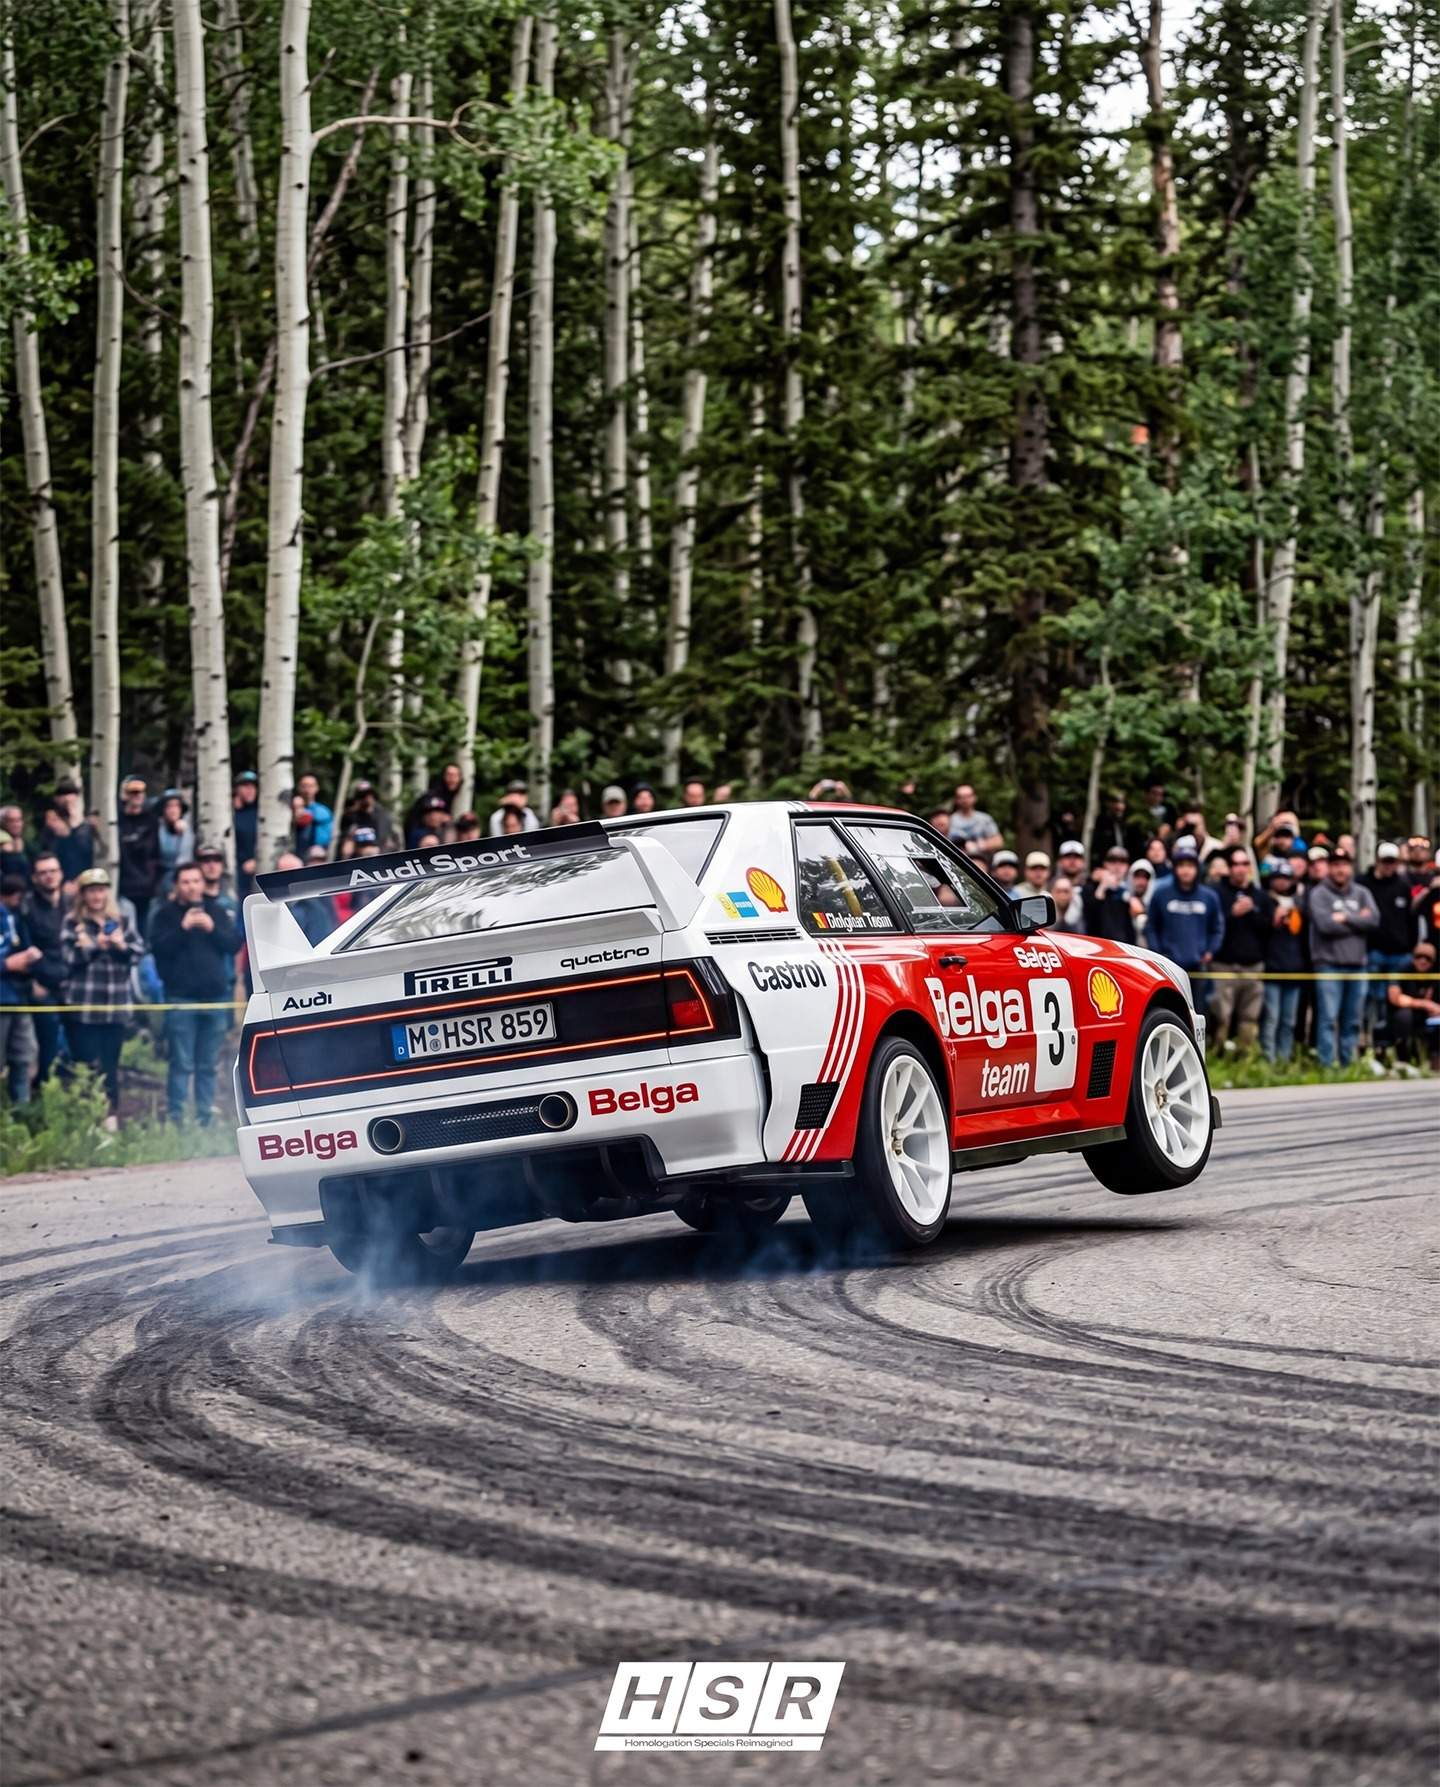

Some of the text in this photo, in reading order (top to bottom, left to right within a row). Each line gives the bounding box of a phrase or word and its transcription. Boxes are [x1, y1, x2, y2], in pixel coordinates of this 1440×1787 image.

[350, 844, 532, 887] Audi Sport
[560, 945, 650, 970] quattro
[404, 956, 513, 997] PIRELLI
[747, 960, 827, 992] Castrol
[282, 991, 333, 1012] Audi
[924, 974, 1027, 1049] Belga
[500, 1008, 548, 1040] 859
[1044, 992, 1065, 1066] 3
[397, 1047, 404, 1055] D
[981, 1059, 1030, 1098] team
[588, 1082, 699, 1117] Belga
[257, 1129, 359, 1161] Belga
